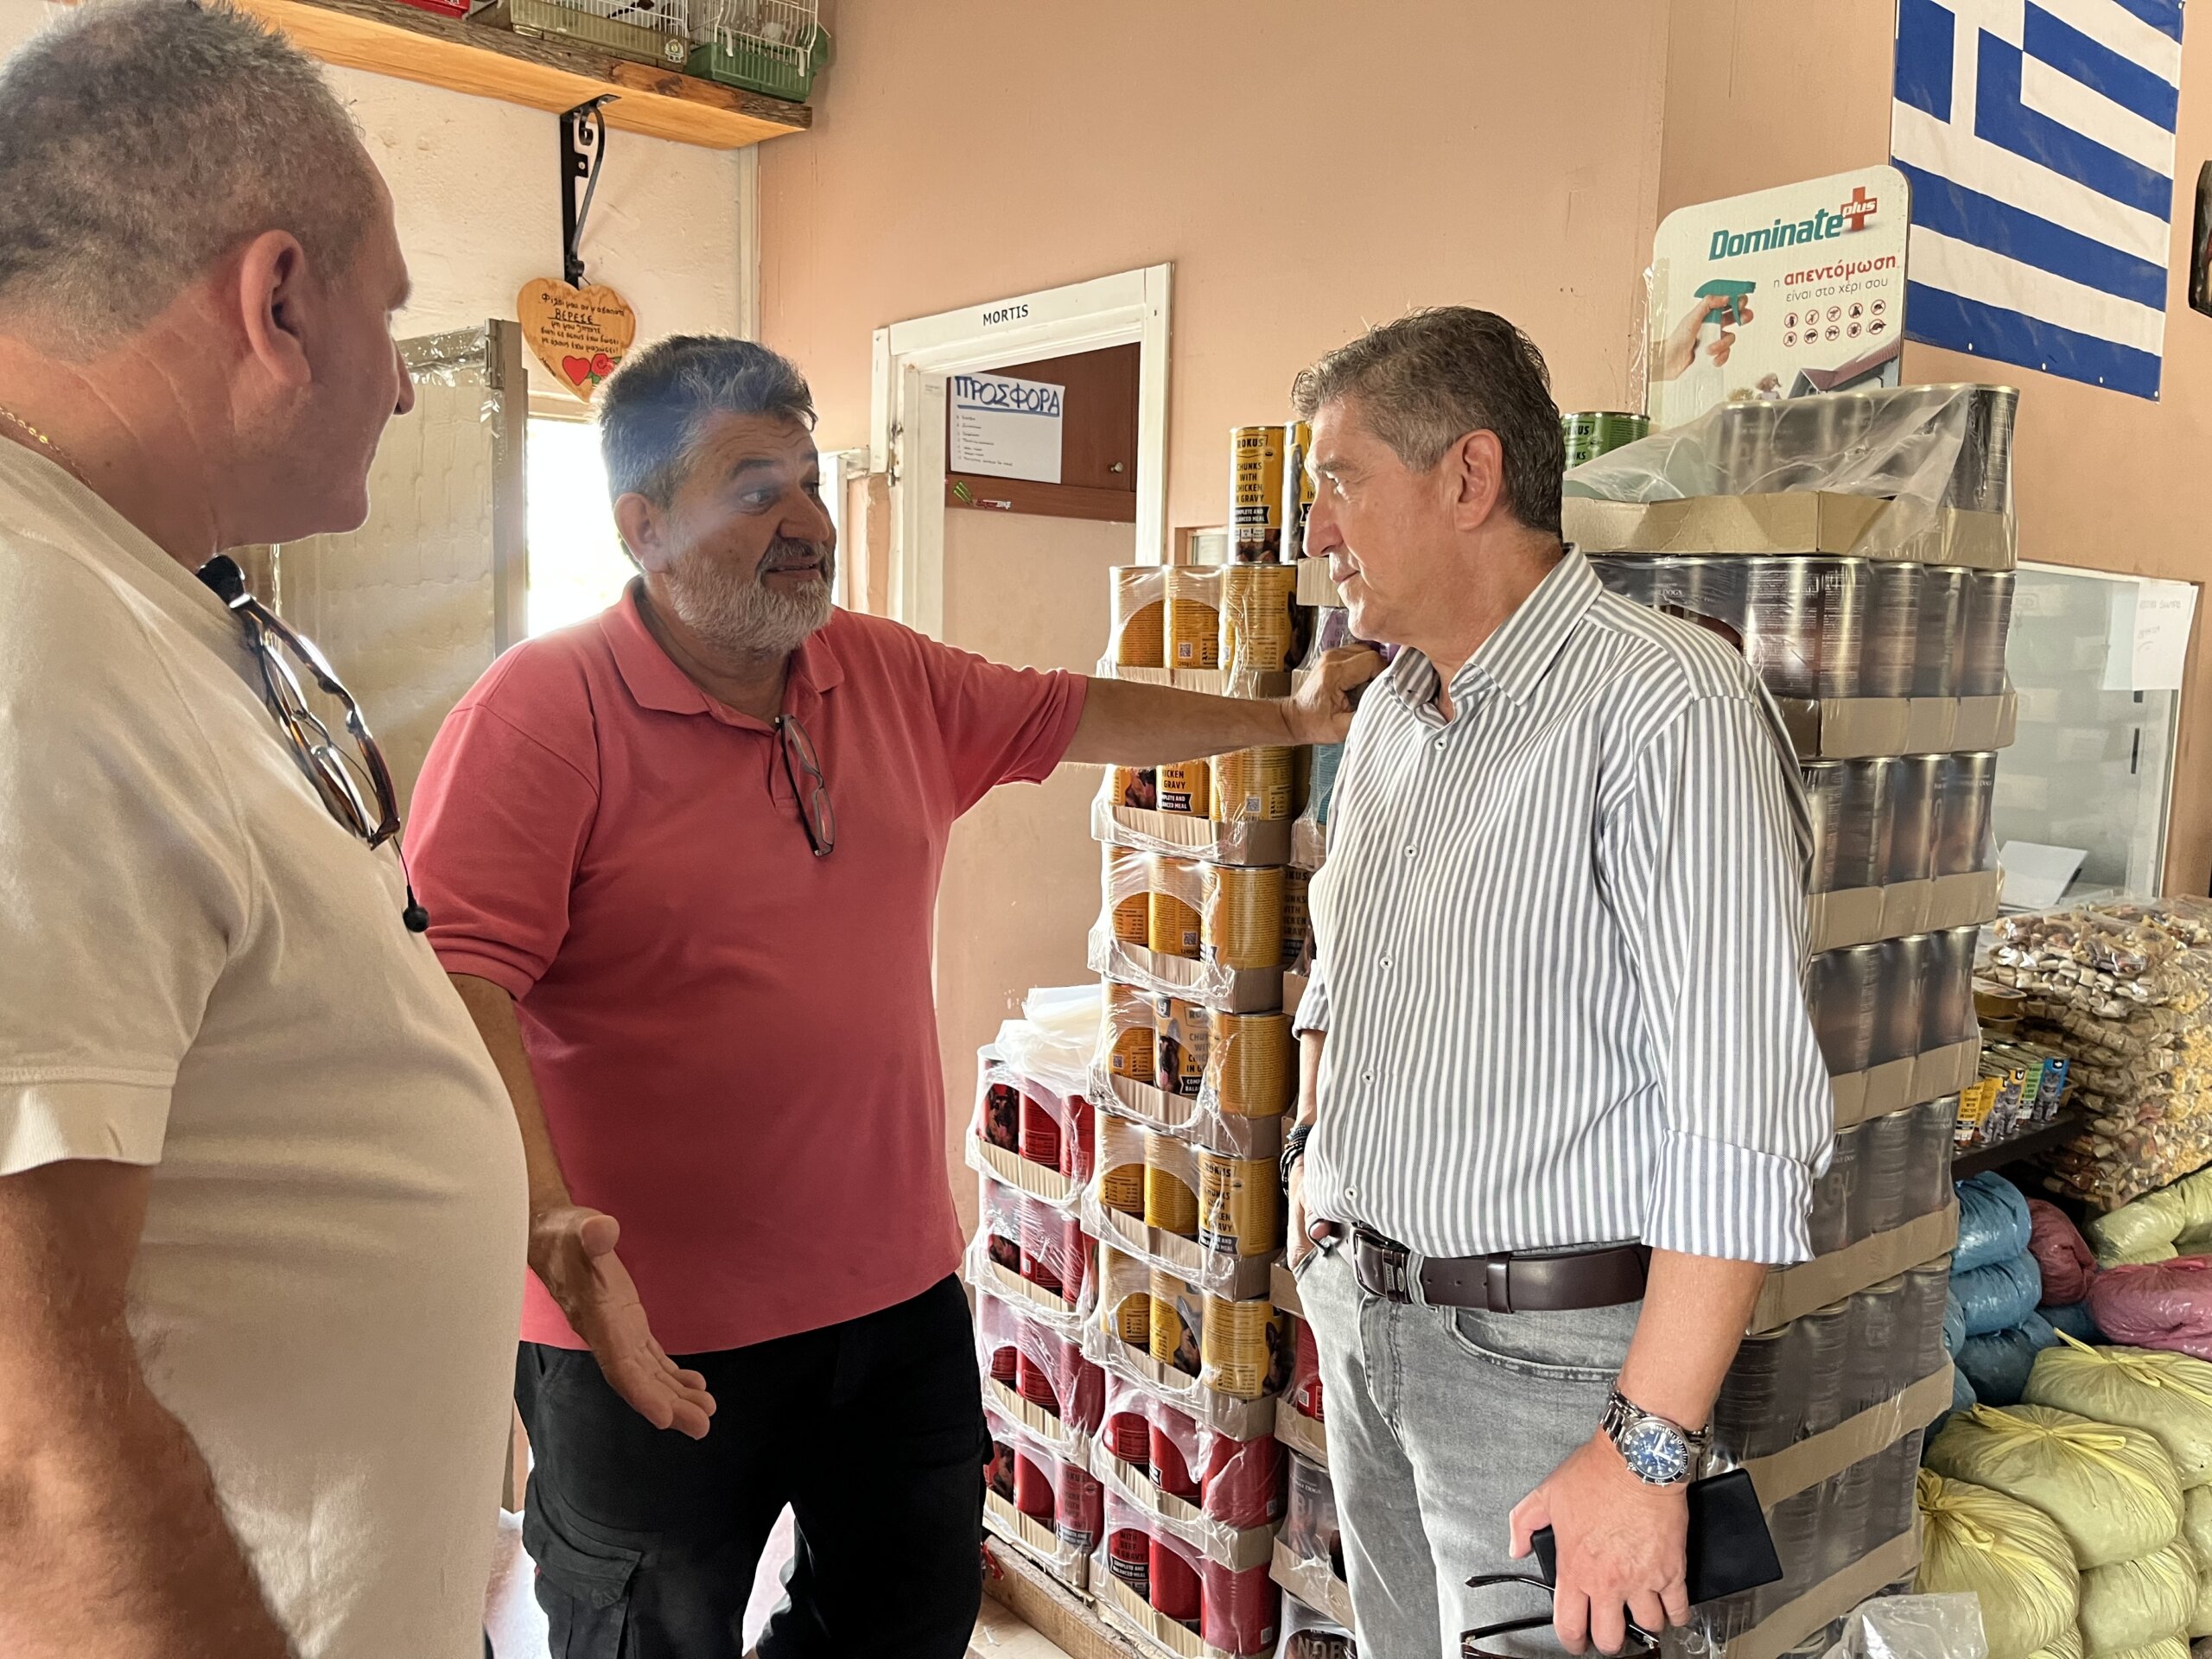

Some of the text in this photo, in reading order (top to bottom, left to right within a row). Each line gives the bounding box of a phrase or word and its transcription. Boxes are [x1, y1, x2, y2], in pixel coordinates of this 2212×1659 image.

[1708, 200, 1877, 261] Dominate plus
[1773, 254, 1897, 289] η απεντόμωση
[1786, 276, 1889, 302] είναι στο χέρι σου
[982, 304, 1028, 326] MORTIS
[955, 376, 1060, 416] ΠΡΟΣΦΟΡΑ
[1239, 474, 1257, 482] WITH
[1241, 494, 1264, 503] GRAVY
[1164, 780, 1186, 790] GRAVY
[1186, 1065, 1196, 1073] IN
